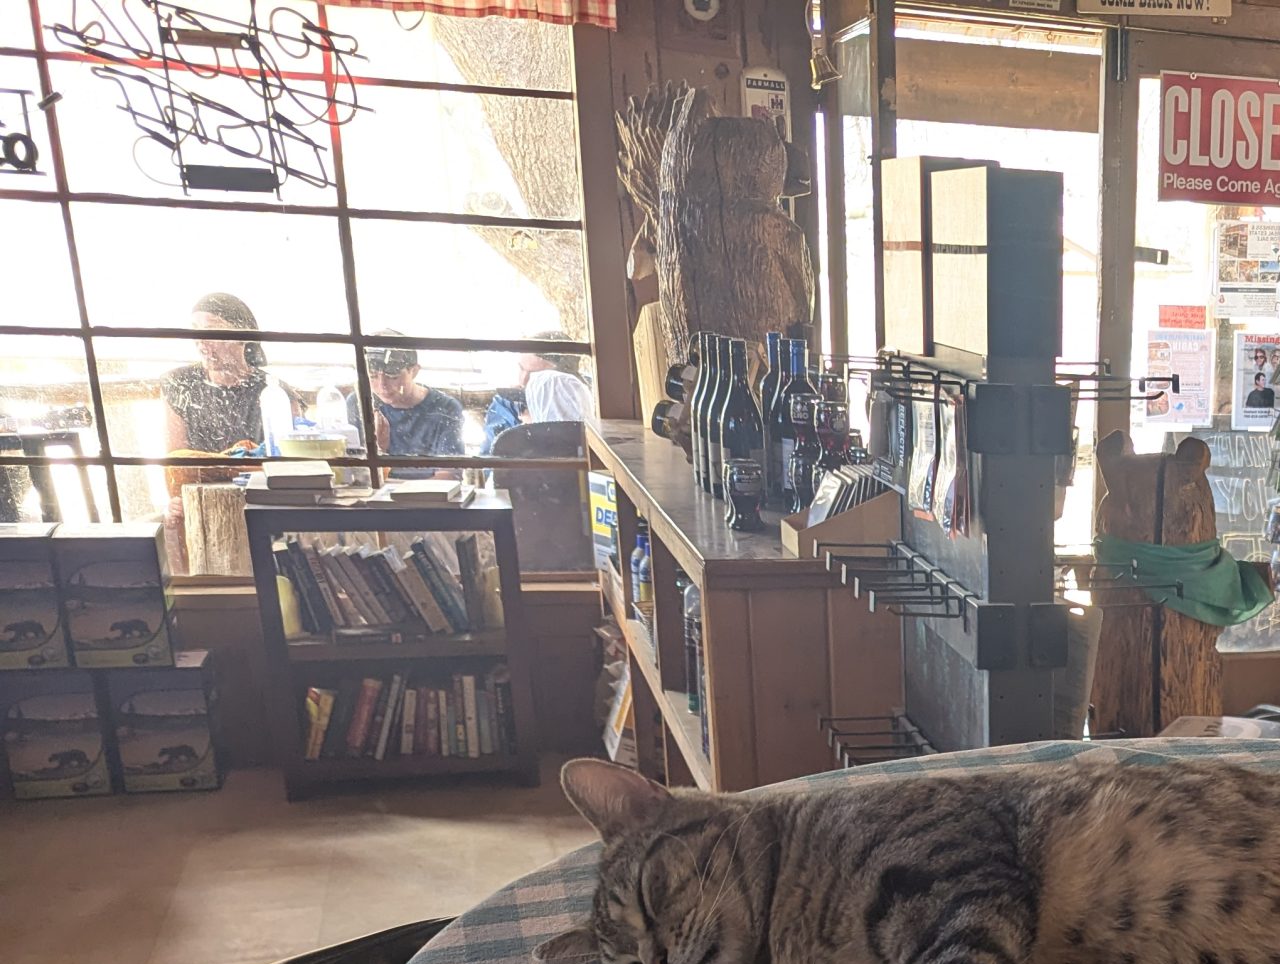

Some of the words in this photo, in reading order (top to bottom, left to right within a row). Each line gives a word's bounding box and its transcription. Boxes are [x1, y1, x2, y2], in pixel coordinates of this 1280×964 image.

[747, 79, 785, 90] FARMALL
[1163, 173, 1212, 191] Please
[1216, 176, 1261, 194] Come
[1244, 335, 1280, 346] Missing
